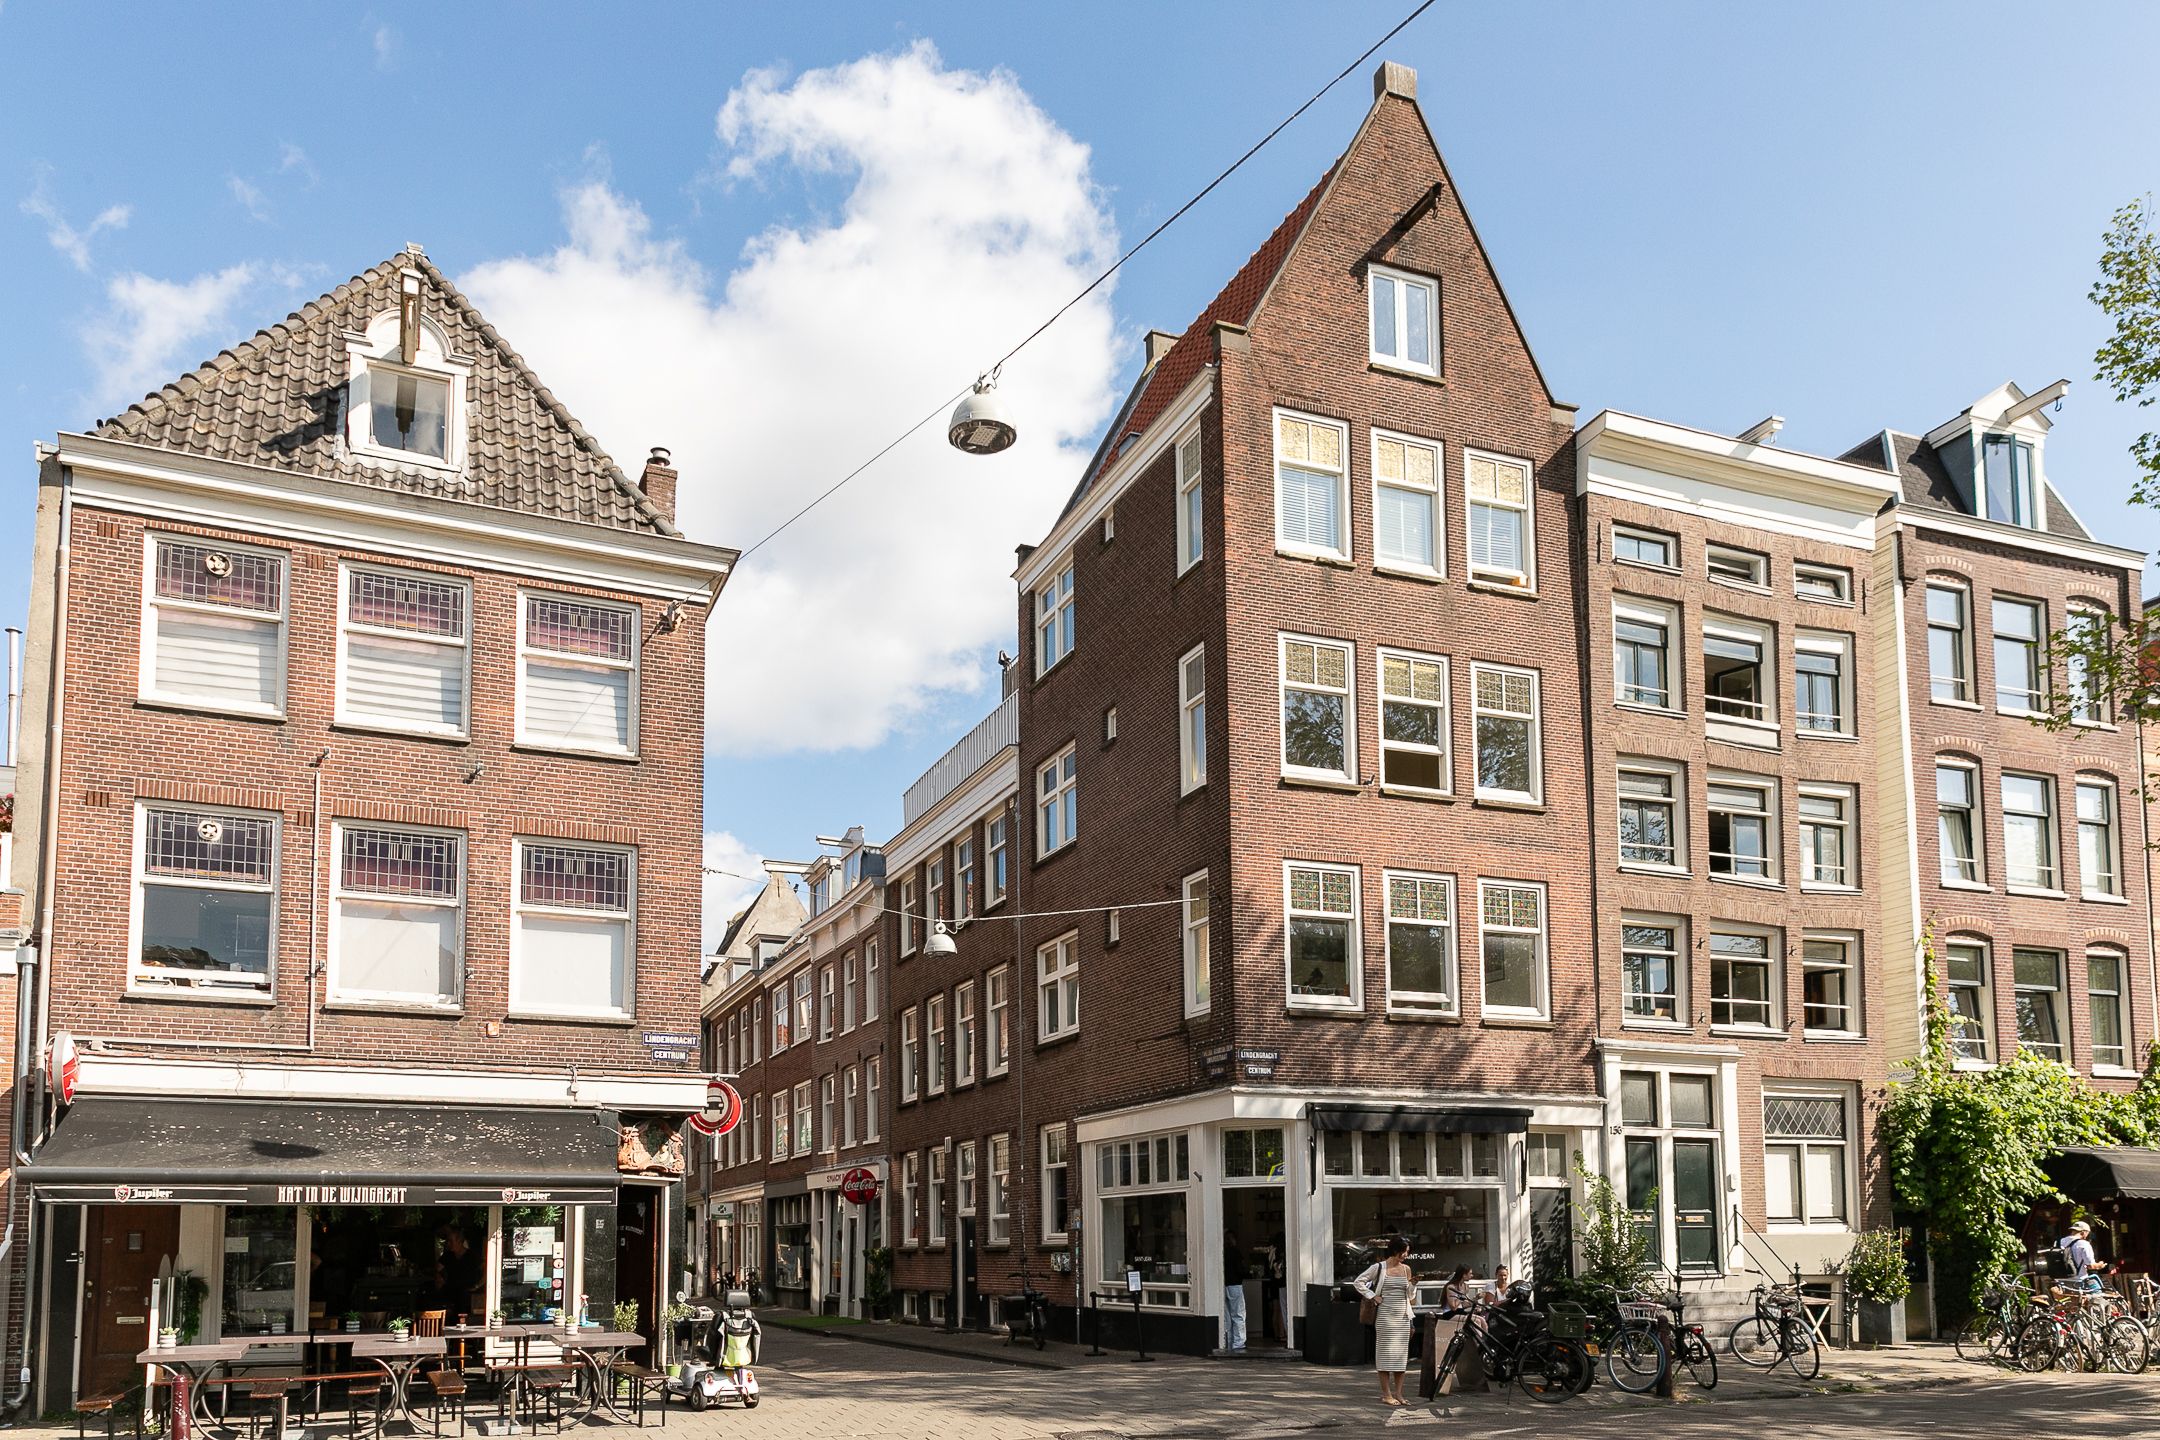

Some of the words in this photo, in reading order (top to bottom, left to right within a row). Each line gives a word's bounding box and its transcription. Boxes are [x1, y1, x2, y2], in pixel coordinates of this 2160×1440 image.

[644, 1034, 697, 1045] LINDENGRACHT
[653, 1050, 686, 1060] CENTRUM
[1240, 1051, 1278, 1059] LINDENGRACHT
[1248, 1067, 1272, 1075] CENTRUM
[130, 1187, 173, 1200] Jupiler
[320, 1186, 337, 1203] DE
[515, 1190, 550, 1202] Jupiler
